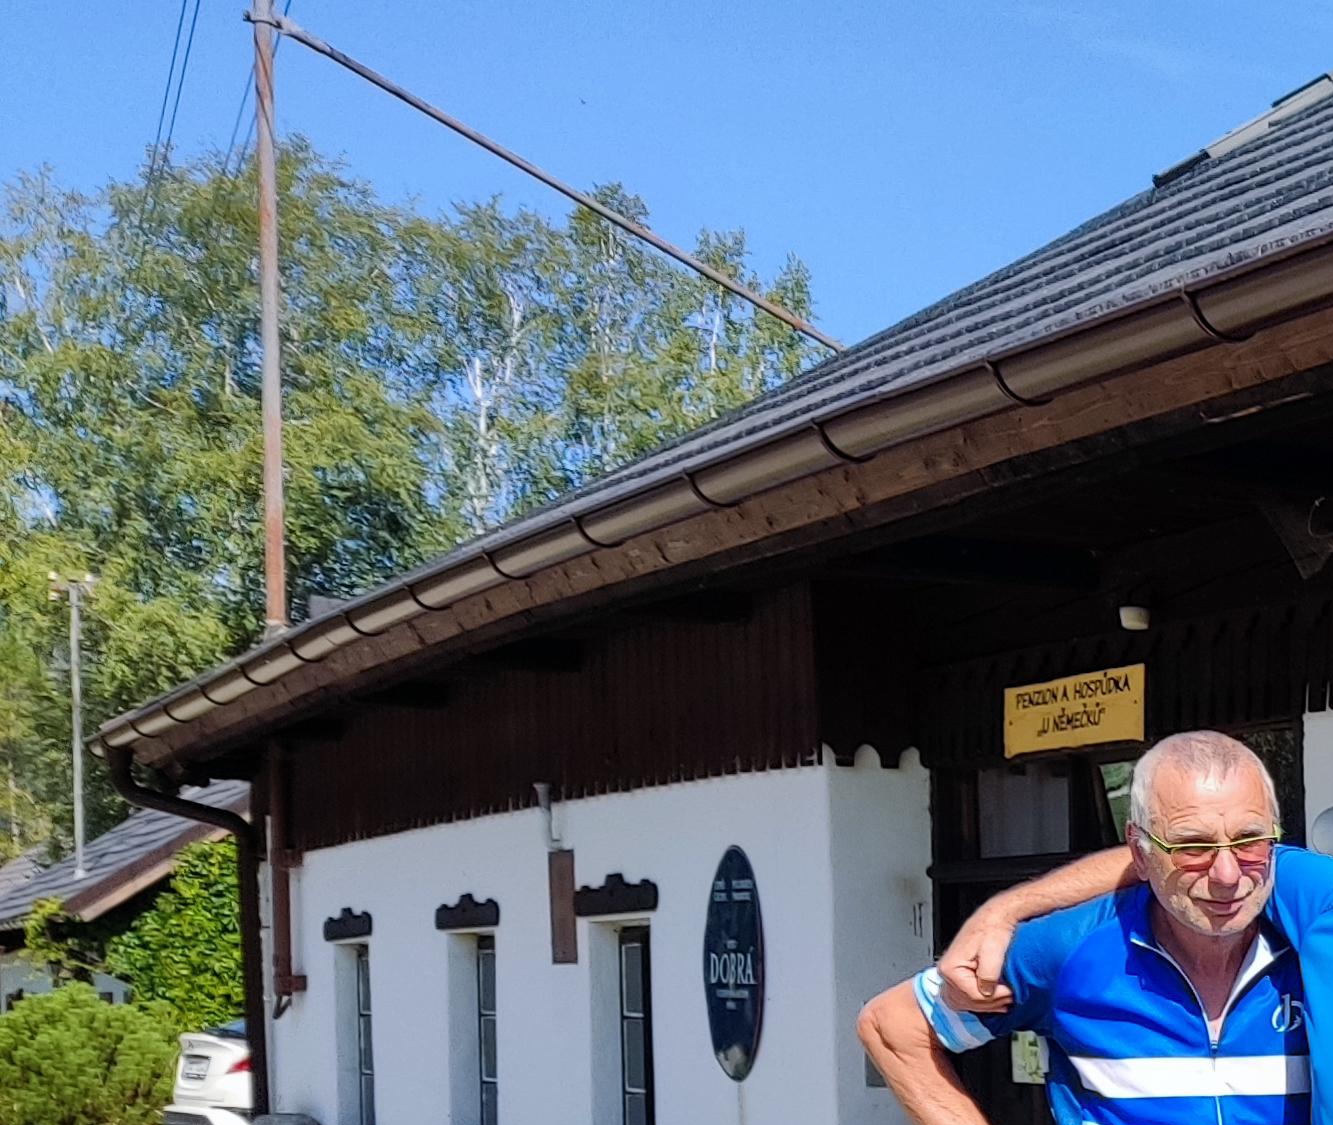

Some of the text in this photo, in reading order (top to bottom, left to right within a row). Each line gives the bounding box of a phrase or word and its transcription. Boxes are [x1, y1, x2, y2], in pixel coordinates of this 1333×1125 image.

[1016, 672, 1131, 710] PENZION A HOSPŮDKA
[710, 945, 757, 984] DOBRÁ
